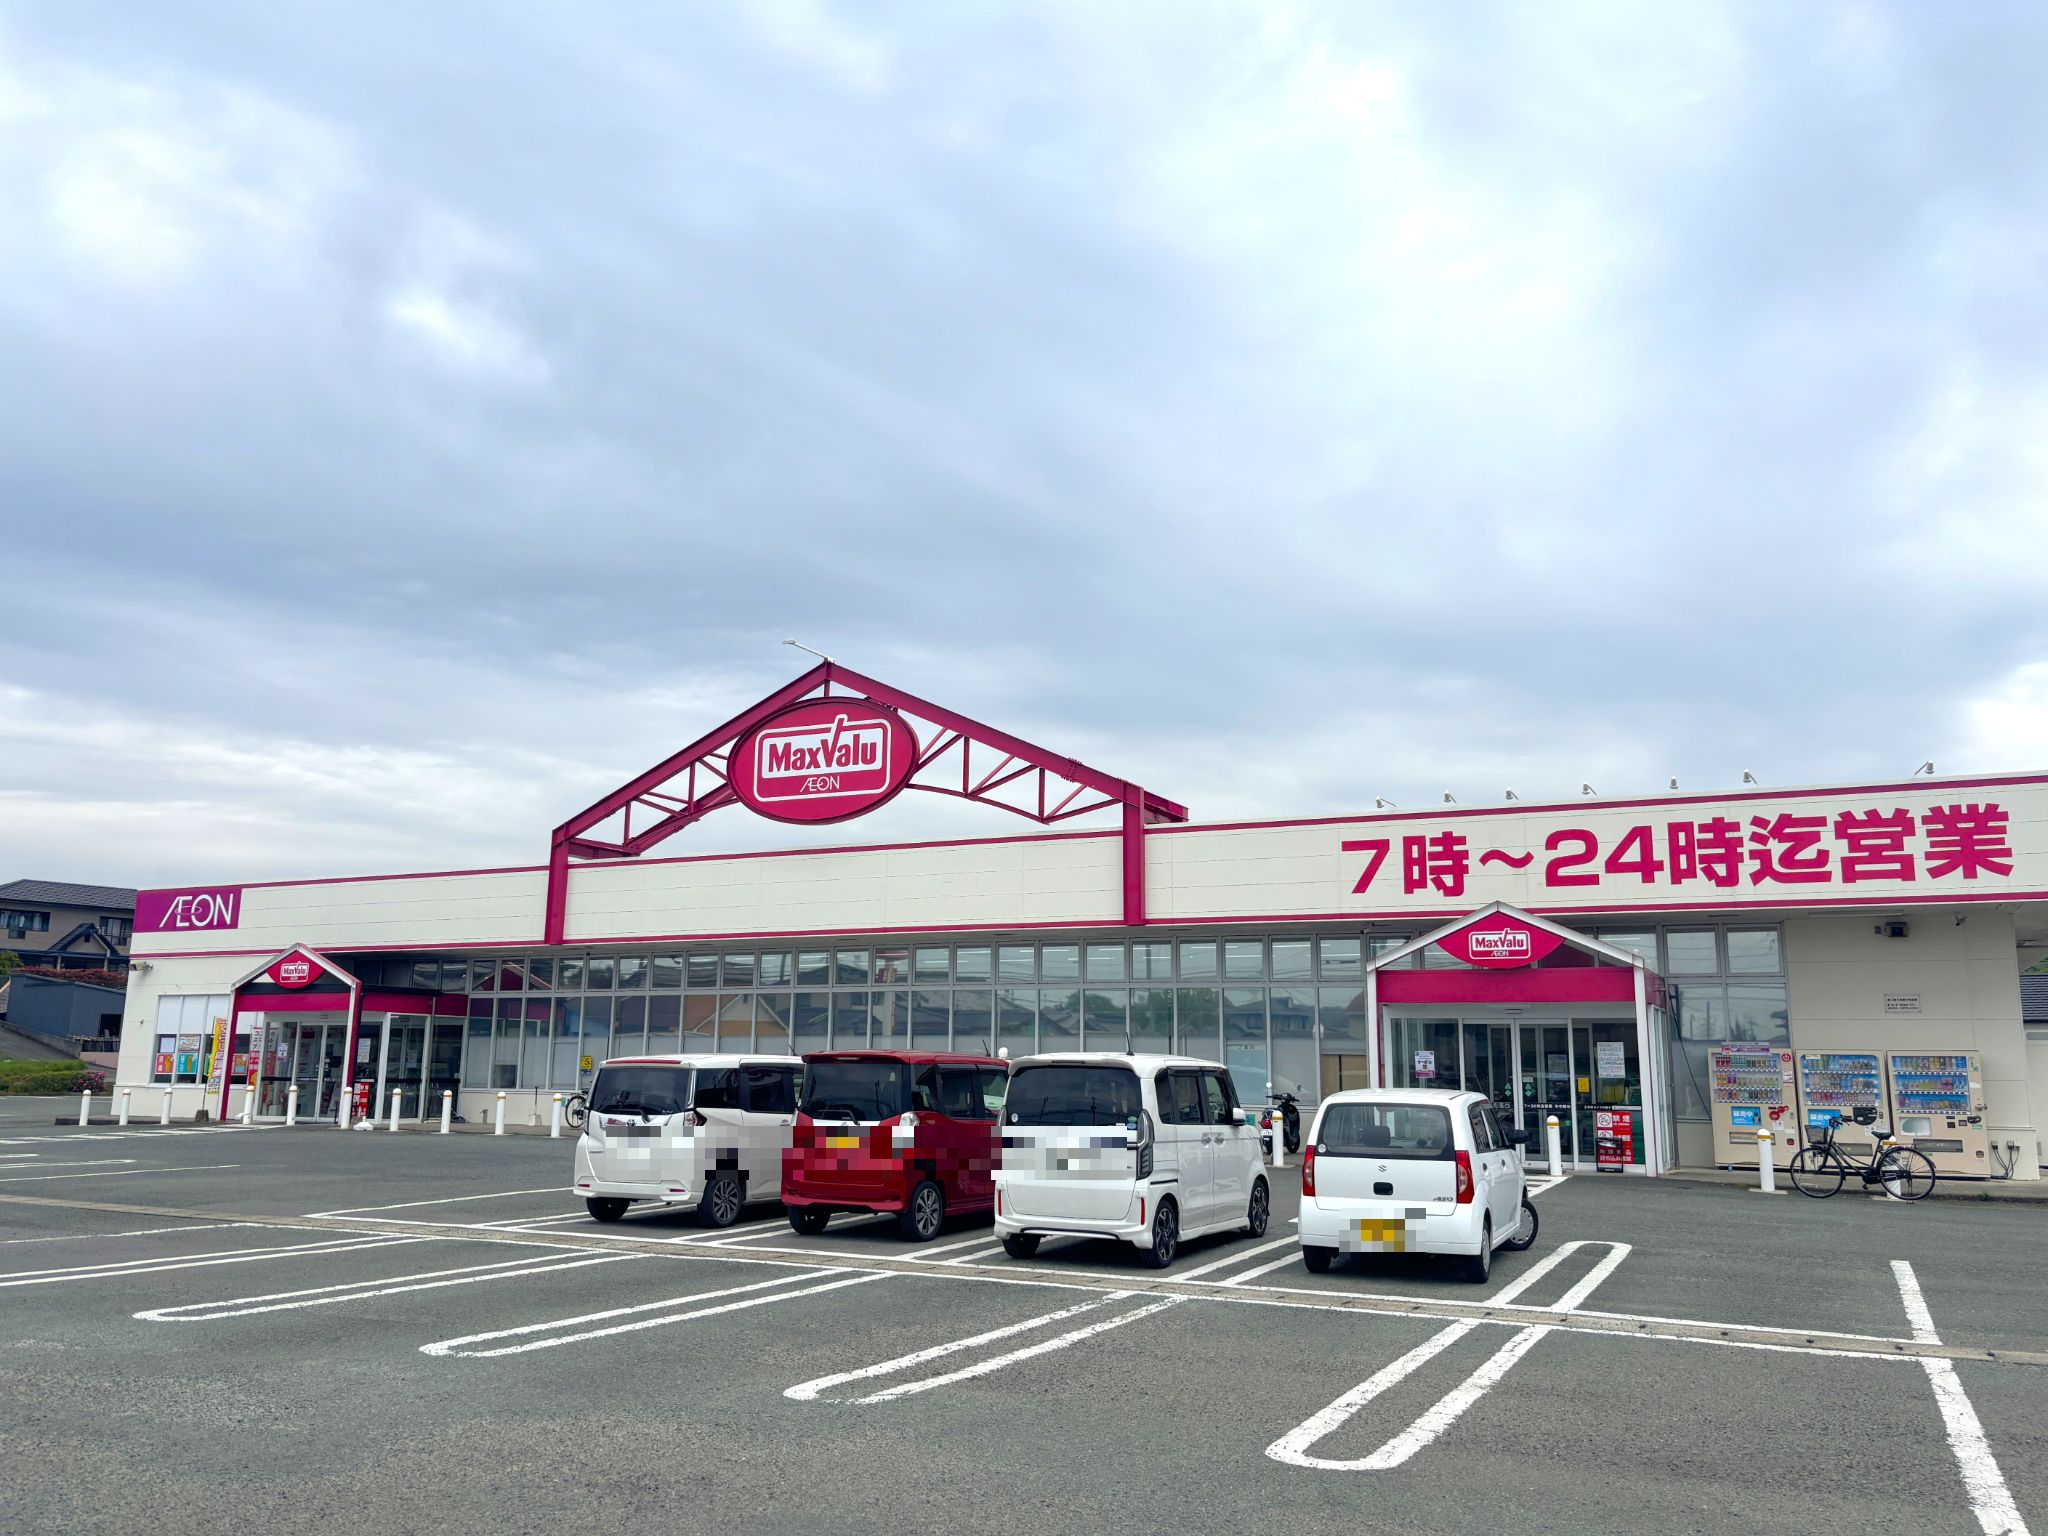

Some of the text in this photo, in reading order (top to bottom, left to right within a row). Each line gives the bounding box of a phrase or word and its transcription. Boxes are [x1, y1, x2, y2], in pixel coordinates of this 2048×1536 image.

[768, 718, 877, 773] MaxValu
[1341, 803, 2014, 897] 7時～24時迄営業
[159, 893, 234, 928] ÆON
[1474, 930, 1525, 949] MaxValu
